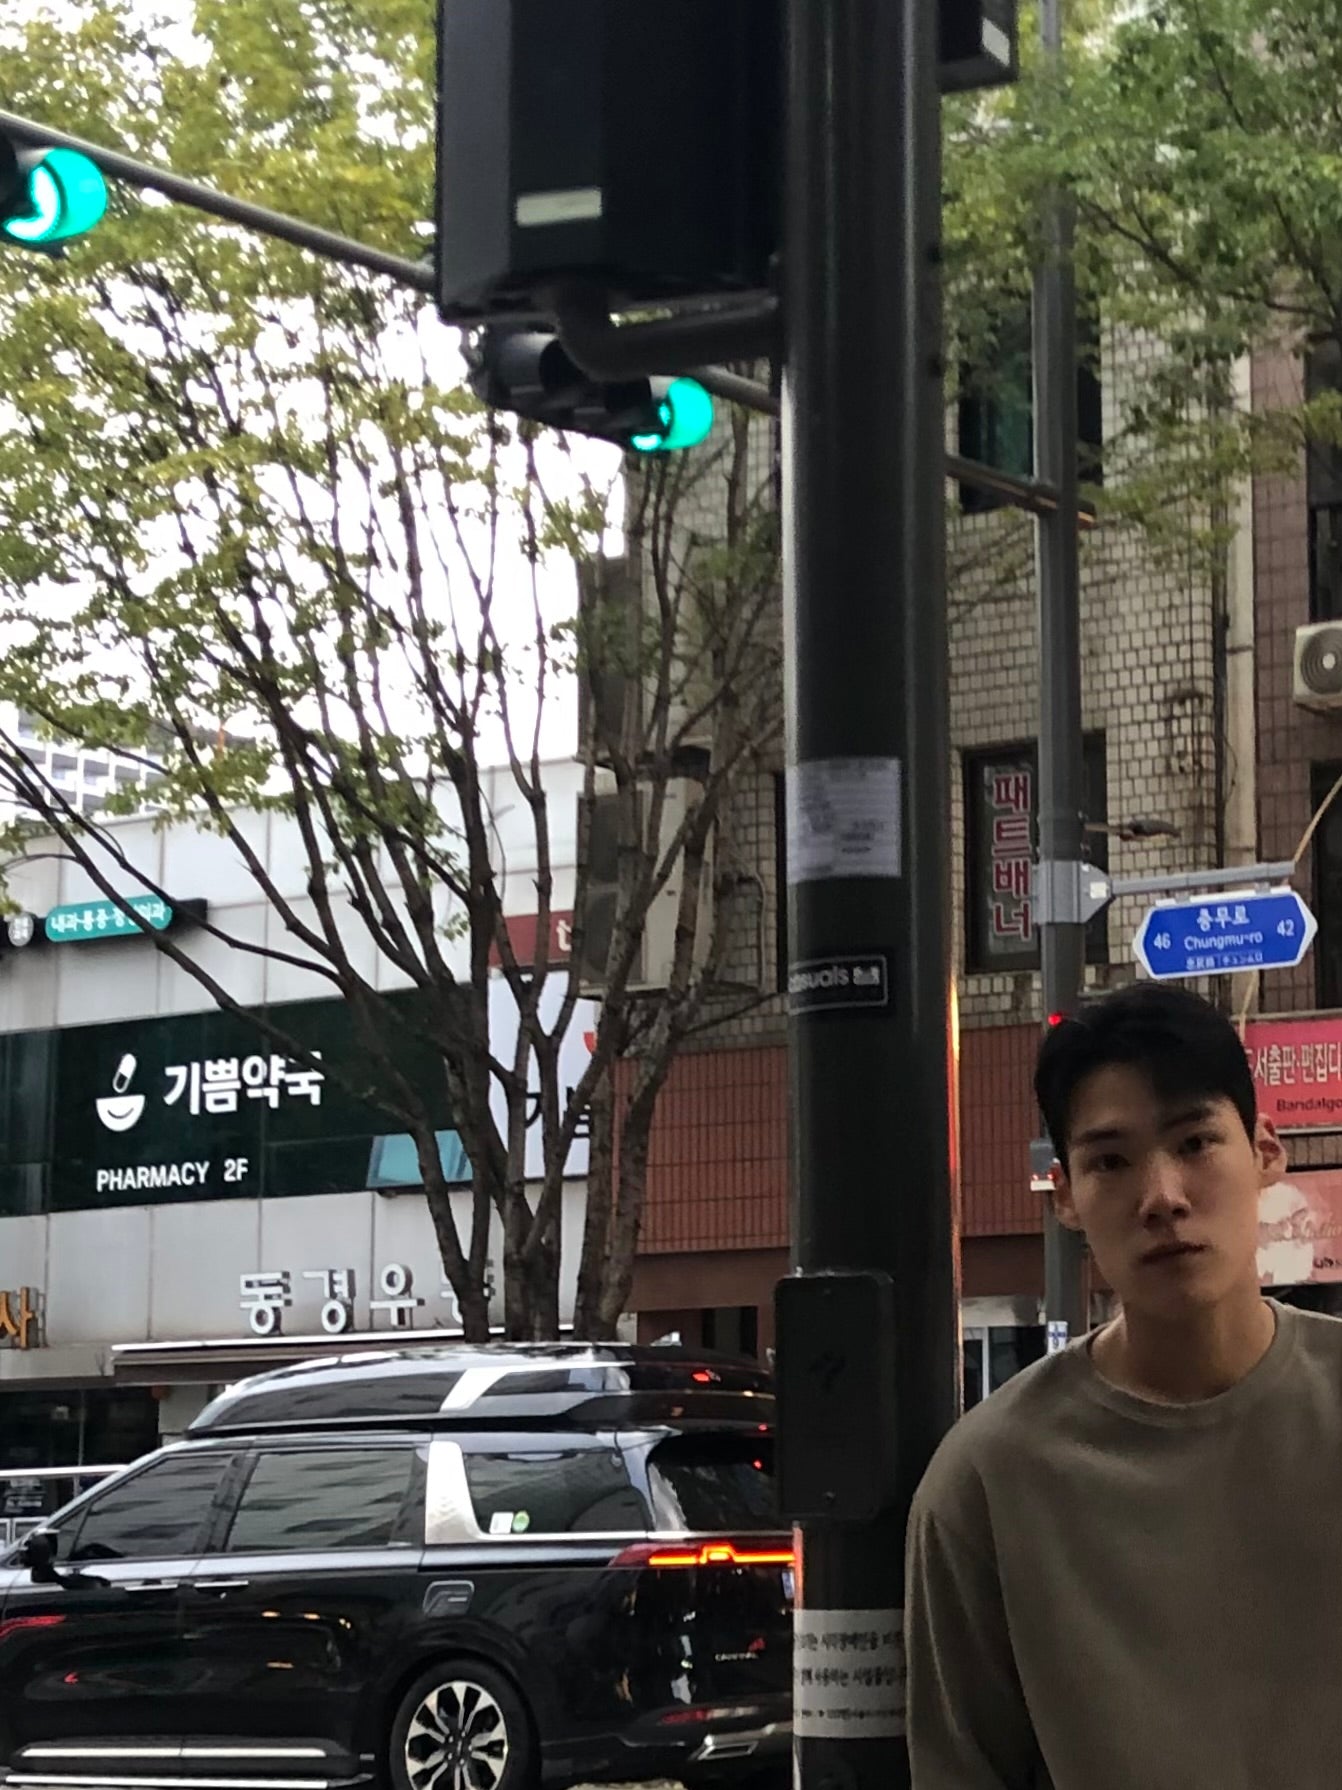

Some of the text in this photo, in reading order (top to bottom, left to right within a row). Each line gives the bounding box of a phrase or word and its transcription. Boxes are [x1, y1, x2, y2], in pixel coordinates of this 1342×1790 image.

[1276, 919, 1295, 937] 42
[1153, 933, 1171, 949] 46
[1184, 931, 1263, 951] Chungmu-ro
[164, 1051, 325, 1115] 기쁨약국
[96, 1158, 249, 1193] PHARMACY 2F
